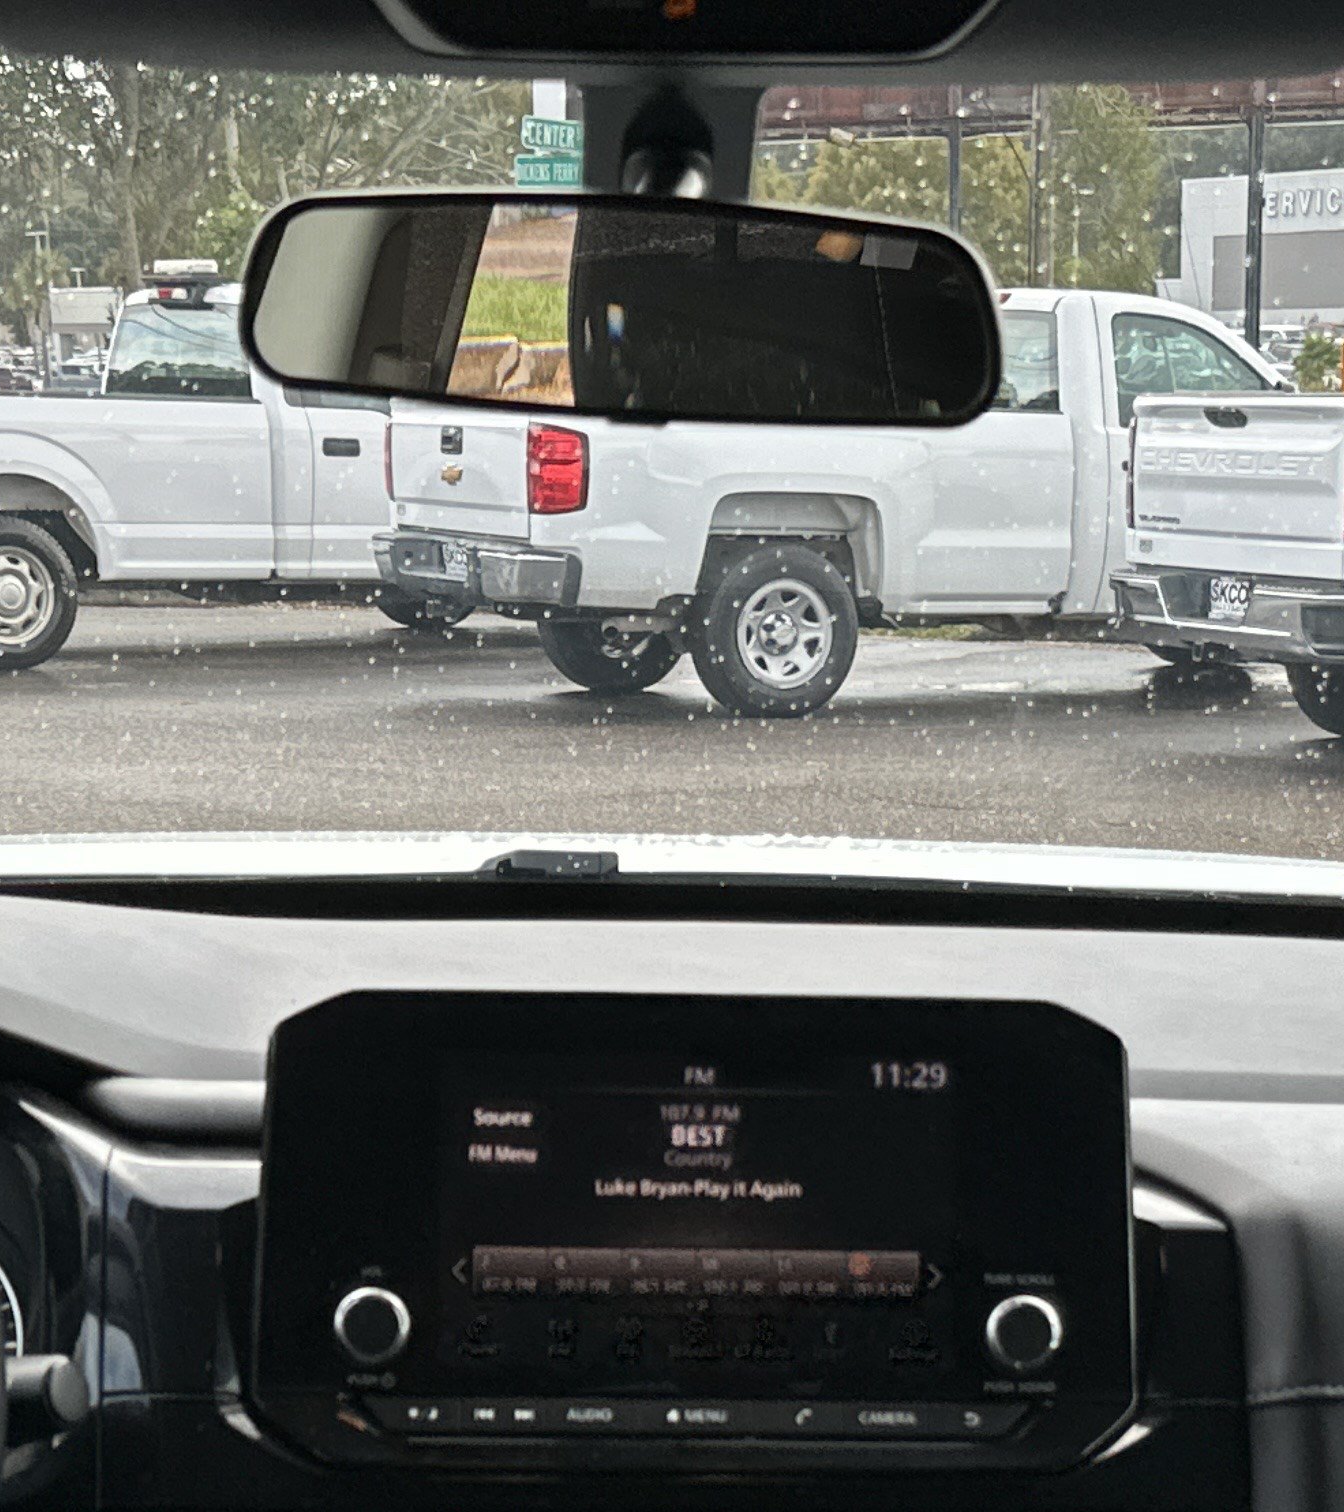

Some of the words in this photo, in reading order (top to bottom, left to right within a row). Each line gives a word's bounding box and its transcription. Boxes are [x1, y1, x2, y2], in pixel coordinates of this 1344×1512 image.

[524, 122, 575, 148] CENTER
[1140, 450, 1324, 476] CHEVROLET
[1210, 579, 1249, 604] SKCO
[683, 1066, 716, 1085] FM
[871, 1062, 948, 1089] 11:29
[472, 1106, 534, 1128] Source
[712, 1102, 742, 1122] FM
[670, 1123, 727, 1147] BEST
[468, 1143, 493, 1162] FM
[494, 1144, 539, 1164] Menu
[663, 1149, 734, 1172] Country
[594, 1178, 639, 1198] Luke
[733, 1178, 745, 1199] it
[749, 1179, 804, 1202] Again
[566, 1408, 614, 1423] AUDIO
[684, 1409, 729, 1424] MENU
[857, 1411, 918, 1426] CAMERA
